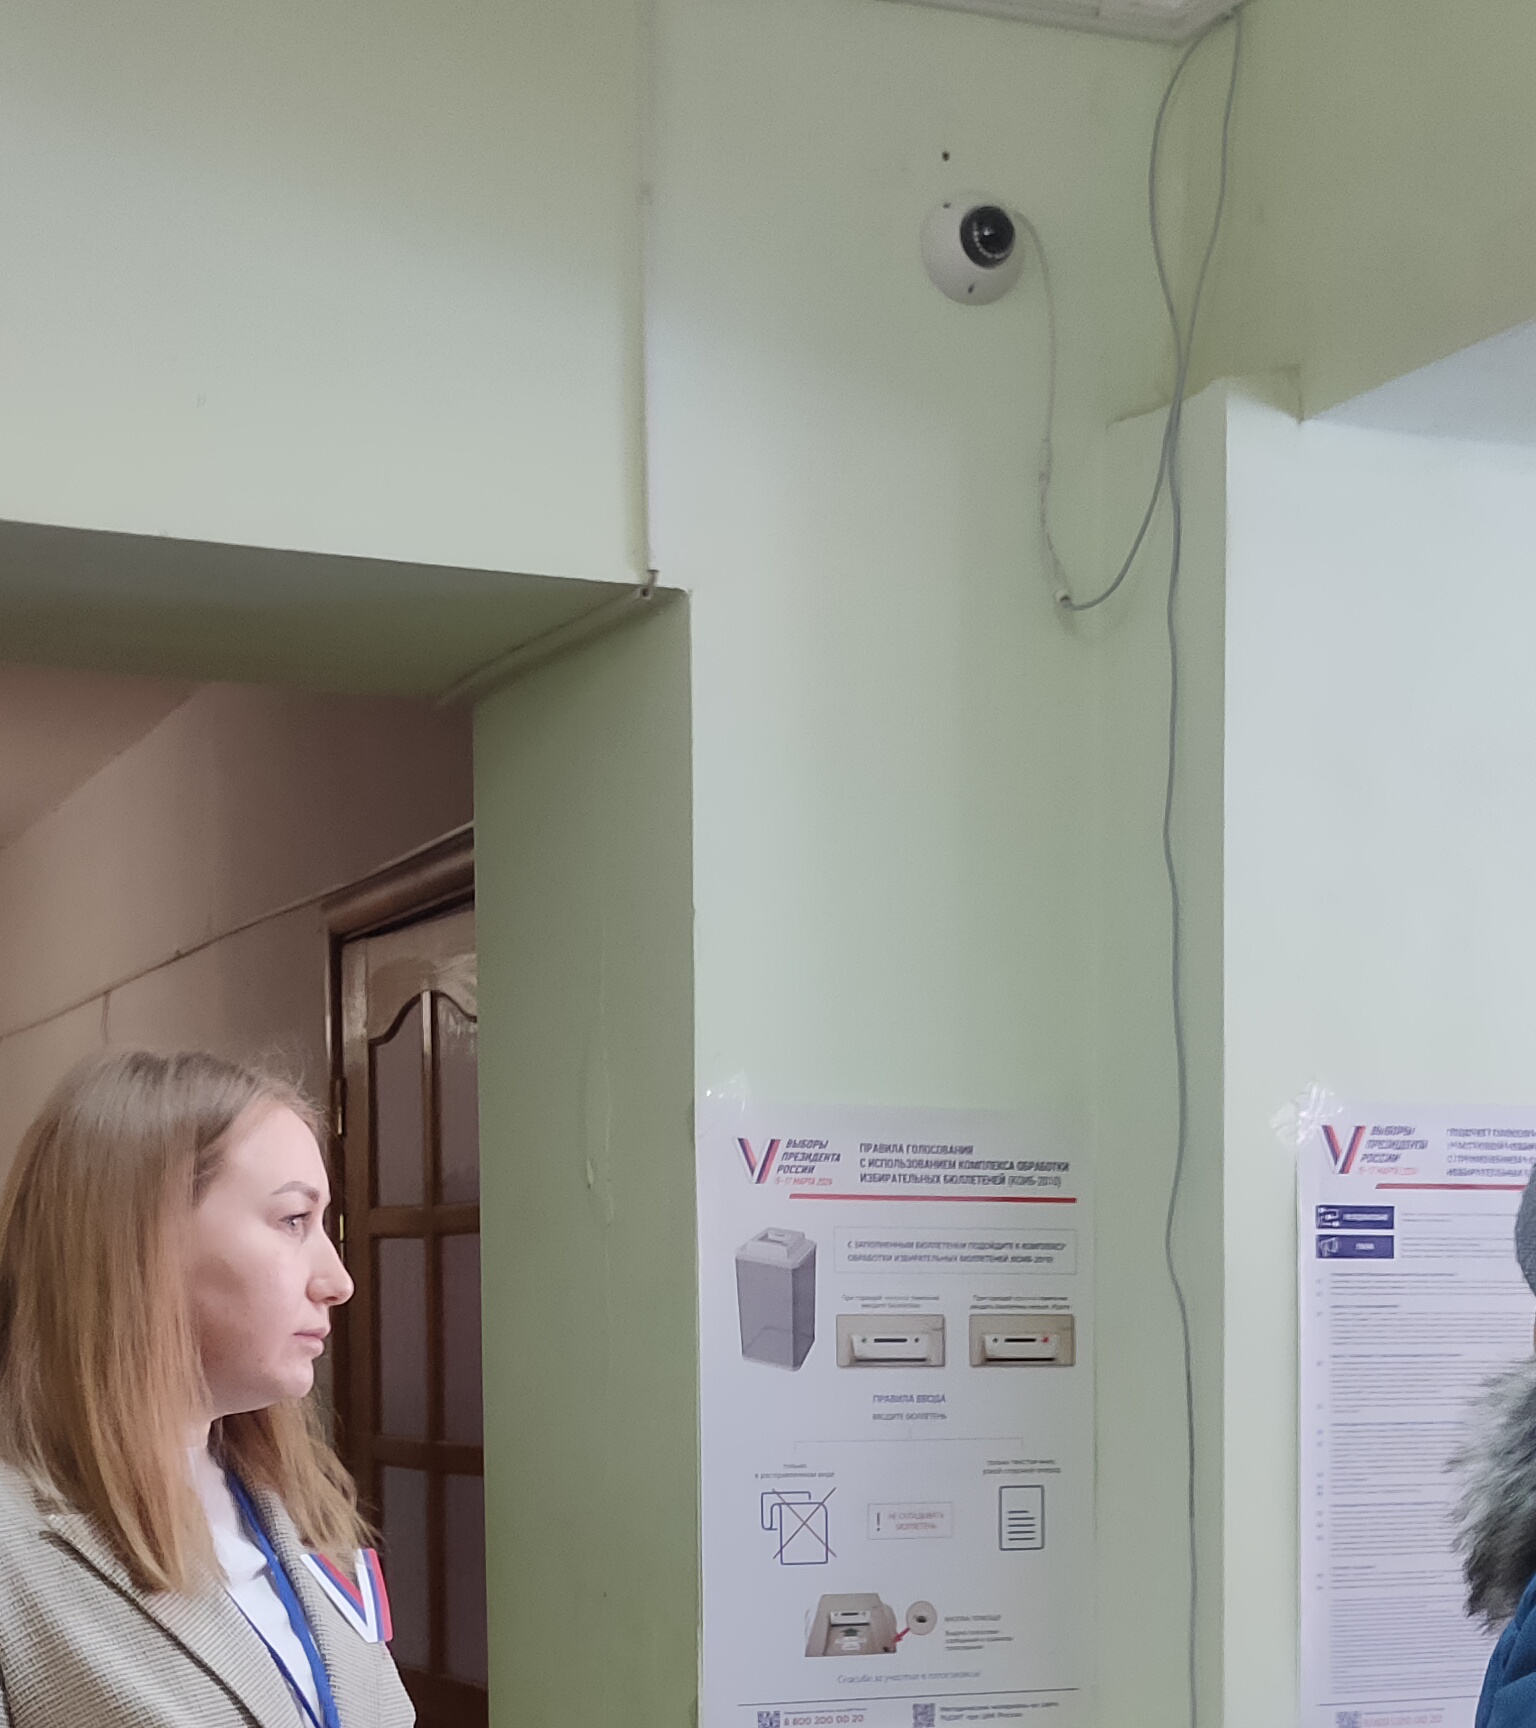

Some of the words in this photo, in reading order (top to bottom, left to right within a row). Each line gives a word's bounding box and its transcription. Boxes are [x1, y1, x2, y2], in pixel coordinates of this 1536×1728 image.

[785, 1138, 830, 1149] ВЫБОРЫ
[859, 1142, 904, 1154] ПРАВИЛА
[906, 1144, 974, 1155] ГОЛОСОВАНИЯ
[781, 1151, 842, 1163] ПРЕЗИДЕНТА
[859, 1157, 866, 1168] С
[776, 1164, 816, 1175] РОССИИ
